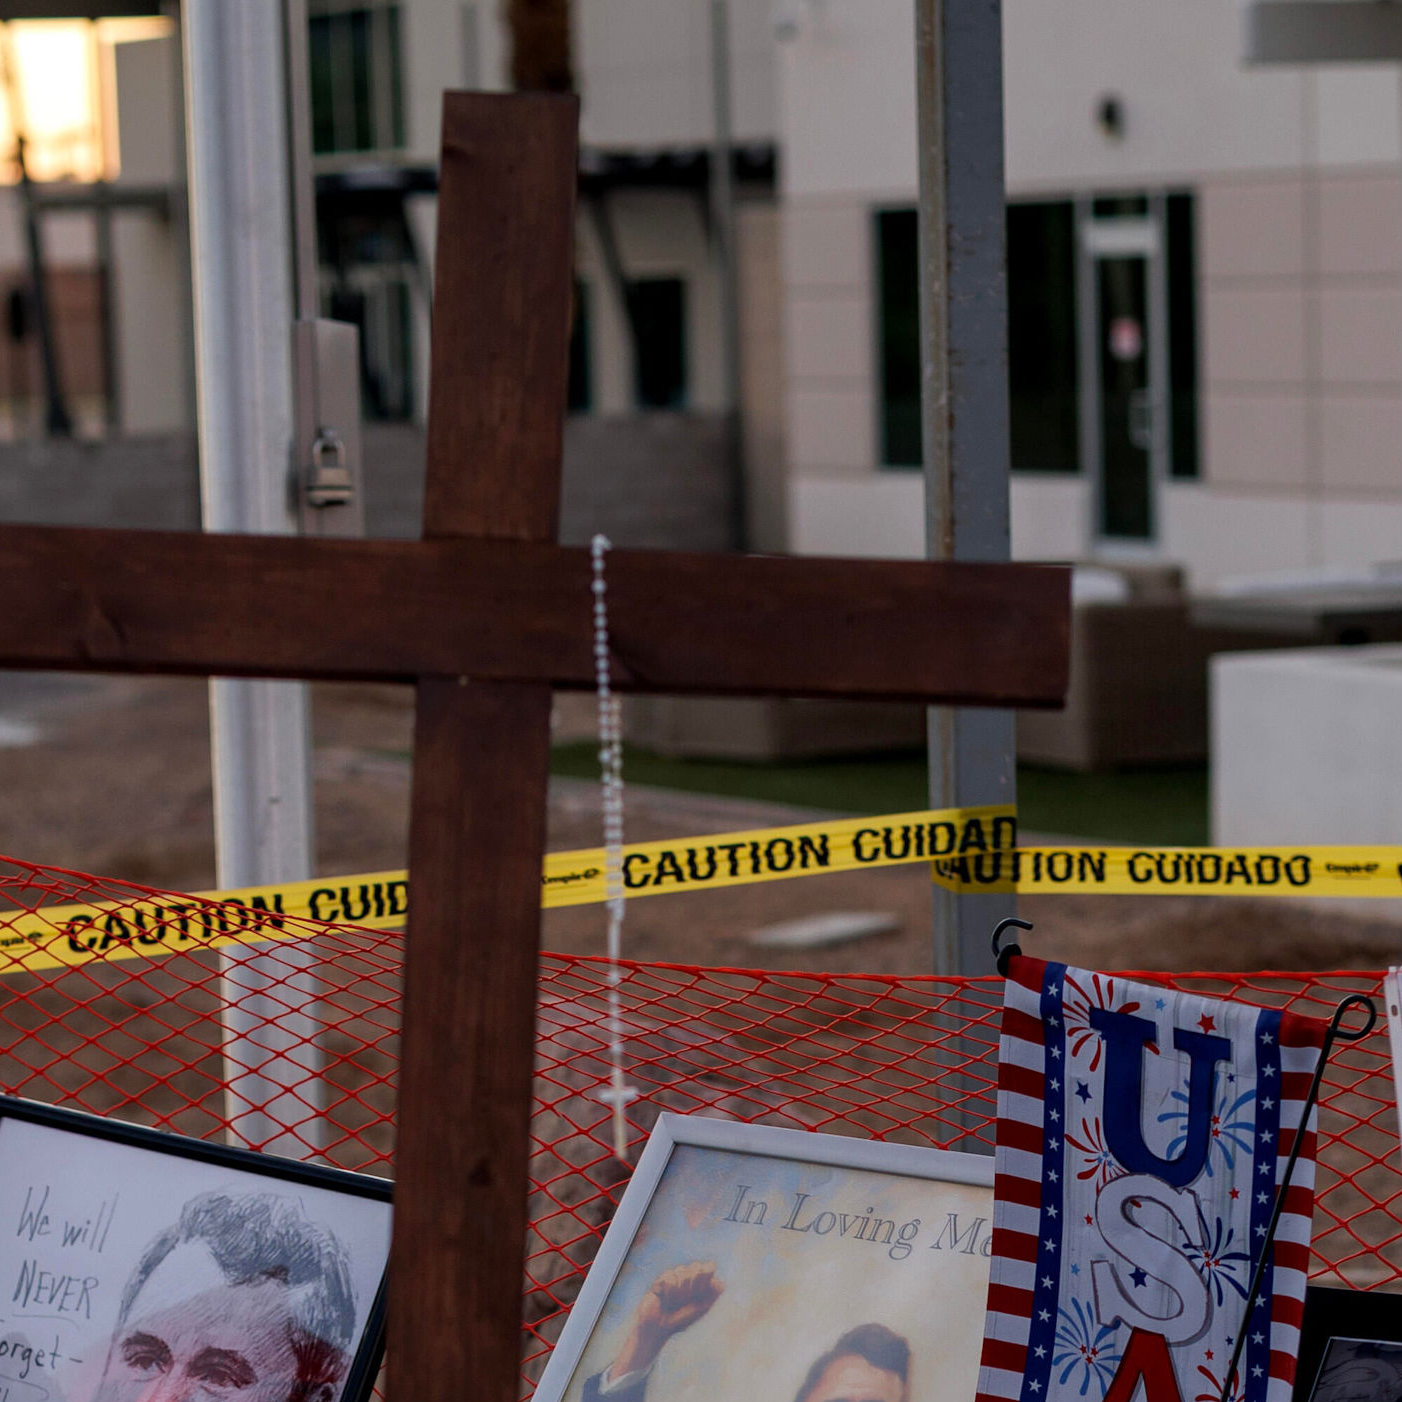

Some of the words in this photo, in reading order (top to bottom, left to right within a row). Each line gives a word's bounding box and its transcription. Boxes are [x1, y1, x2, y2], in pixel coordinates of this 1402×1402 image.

[622, 833, 831, 889] CAUTION
[852, 815, 1017, 863] CUIDAD
[1127, 852, 1312, 886] CUIDADO
[66, 892, 285, 954] CAUTION
[308, 879, 408, 924] CUID
[17, 1185, 51, 1242] We
[61, 1192, 119, 1253] will
[724, 1184, 768, 1226] In
[780, 1192, 921, 1260] Loving
[12, 1259, 99, 1319] NEVER
